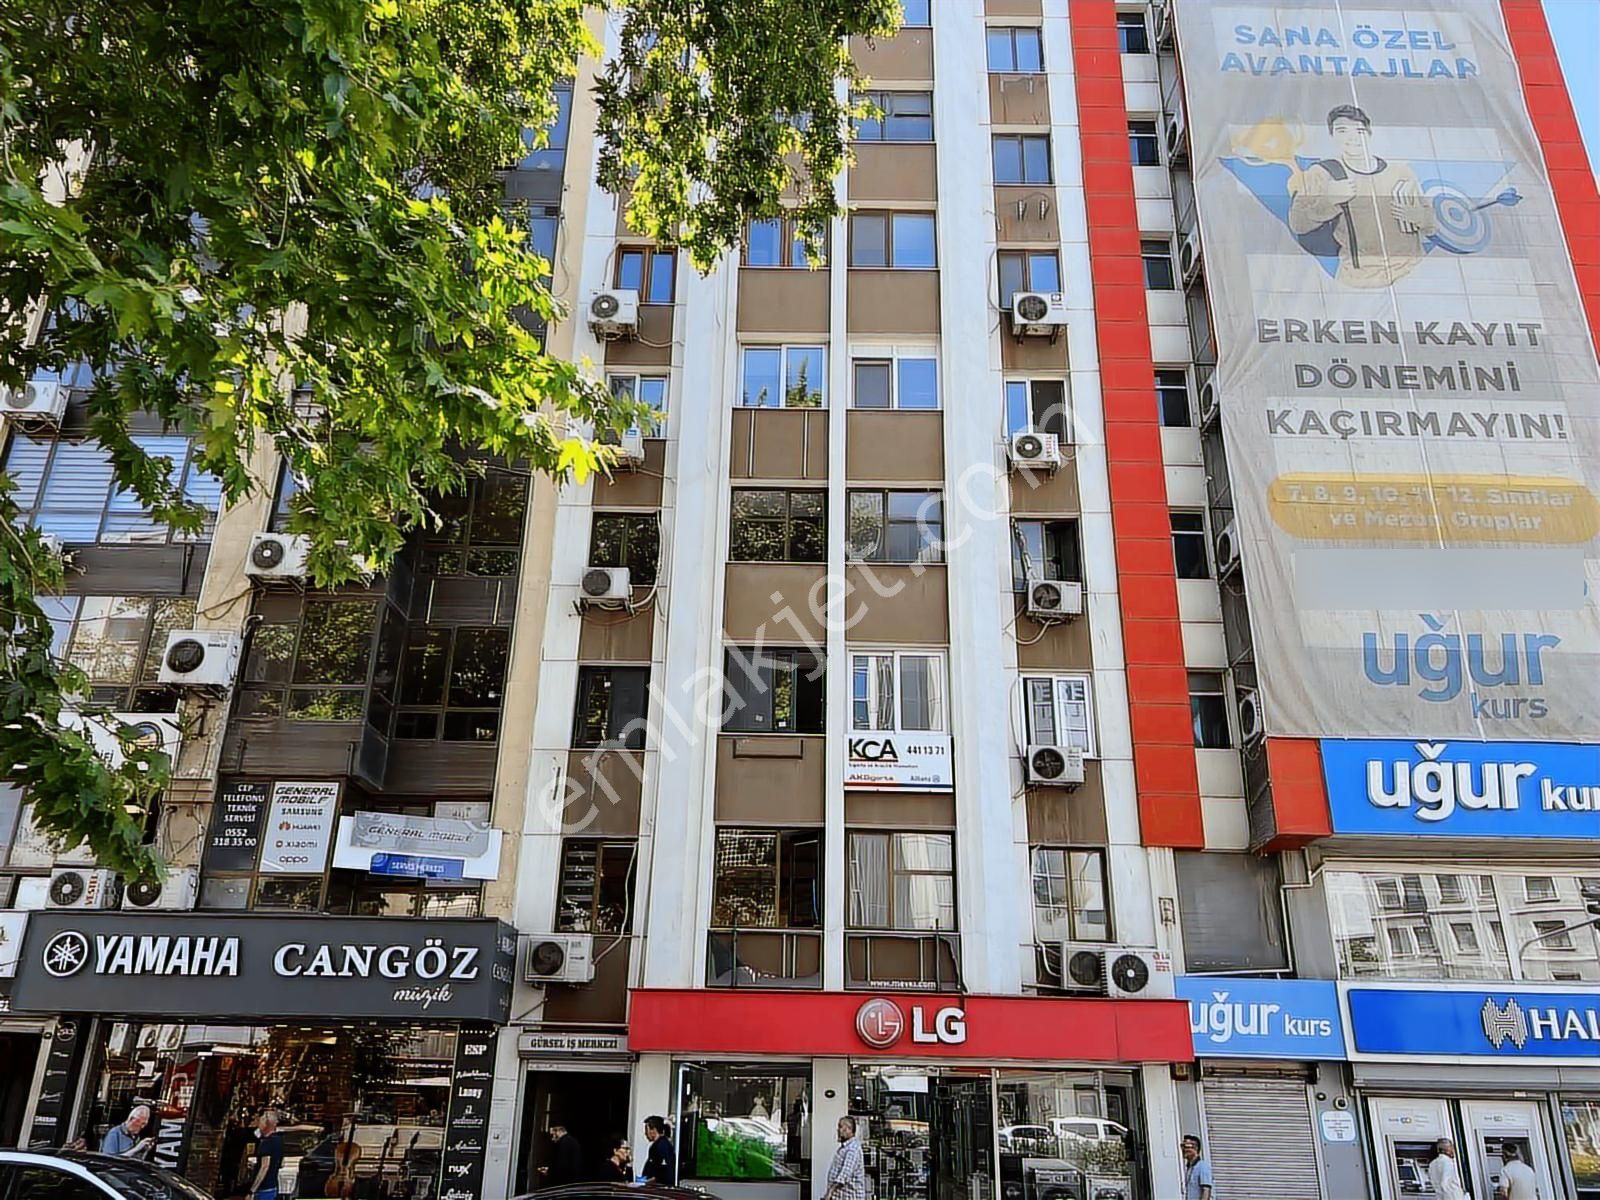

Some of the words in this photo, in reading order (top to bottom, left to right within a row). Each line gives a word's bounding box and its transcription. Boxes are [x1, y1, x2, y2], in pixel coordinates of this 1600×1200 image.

[1235, 25, 1341, 49] SANA
[1352, 24, 1457, 51] ÖZEL
[1221, 52, 1479, 80] AVANTAJLAR
[1257, 318, 1399, 346] ERKEN
[1415, 320, 1543, 347] KAYIT
[1294, 358, 1522, 392] DÖNEMİNİ
[1266, 408, 1568, 441] KAÇIRMAYIN!
[1330, 513, 1357, 526] ve
[1452, 511, 1544, 532] Gruplar
[1362, 613, 1561, 702] uğur
[1470, 692, 1548, 719] kurs
[848, 738, 898, 760] KCA
[907, 746, 922, 755] 441
[924, 746, 934, 755] 13
[935, 747, 945, 756] 71
[237, 784, 254, 792] CEP
[275, 786, 336, 796] GENERAL
[1366, 742, 1538, 822] uğur
[223, 794, 265, 802] TELEFONU
[227, 803, 258, 812] TEKNİK
[281, 807, 323, 816] SAMSUNG
[225, 828, 248, 837] 0552
[244, 838, 257, 847] 00
[95, 935, 240, 977] YAMAHA
[273, 938, 480, 980] CANGÖZ
[393, 984, 455, 1010] müzik
[912, 1006, 966, 1043] LG
[1189, 991, 1280, 1043] uğur
[1284, 1014, 1332, 1037] kurs
[530, 1035, 566, 1049] GÜRSEL
[577, 1036, 618, 1049] MERKEZİ
